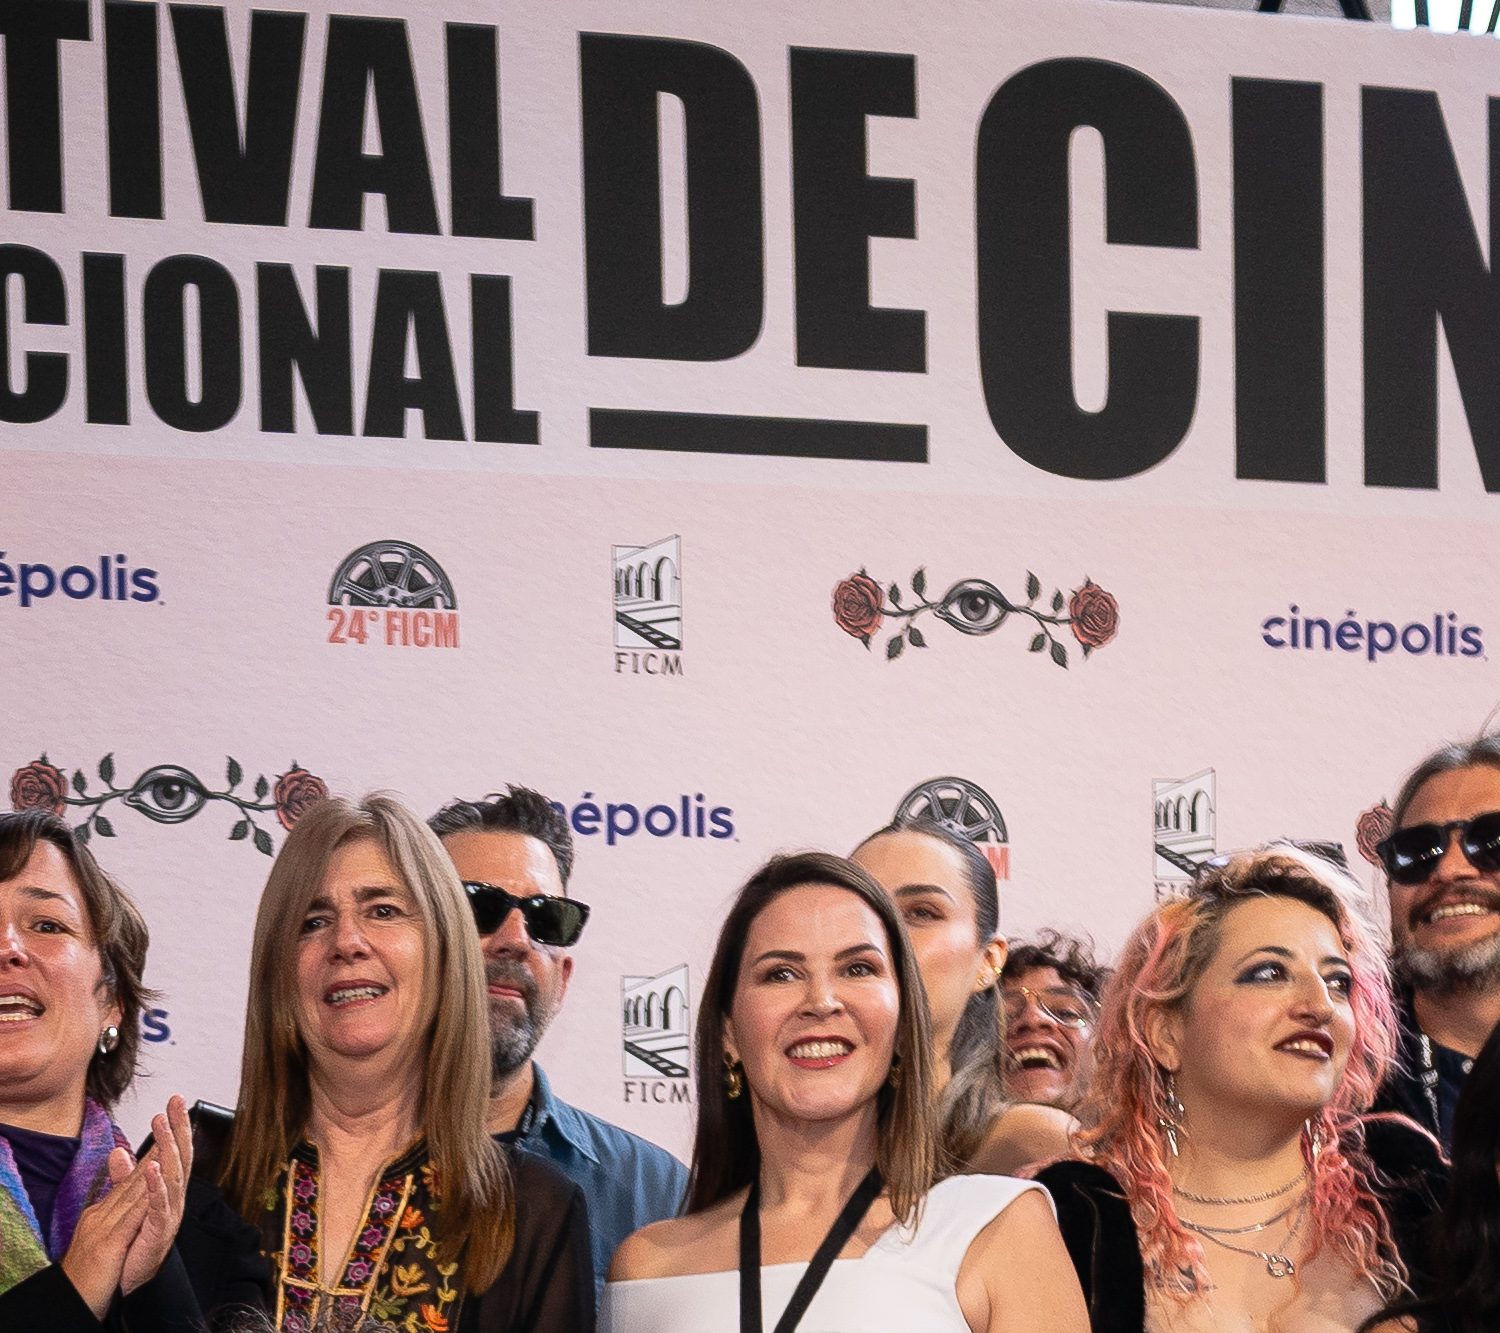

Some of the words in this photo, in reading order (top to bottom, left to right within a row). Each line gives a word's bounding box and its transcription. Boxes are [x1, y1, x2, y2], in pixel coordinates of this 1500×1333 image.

[578, 31, 930, 374] DE
[328, 611, 379, 645] 24°
[386, 612, 460, 649] FICM
[1262, 604, 1484, 662] cinépolis
[614, 651, 684, 676] FICM
[624, 1081, 691, 1103] FICM
